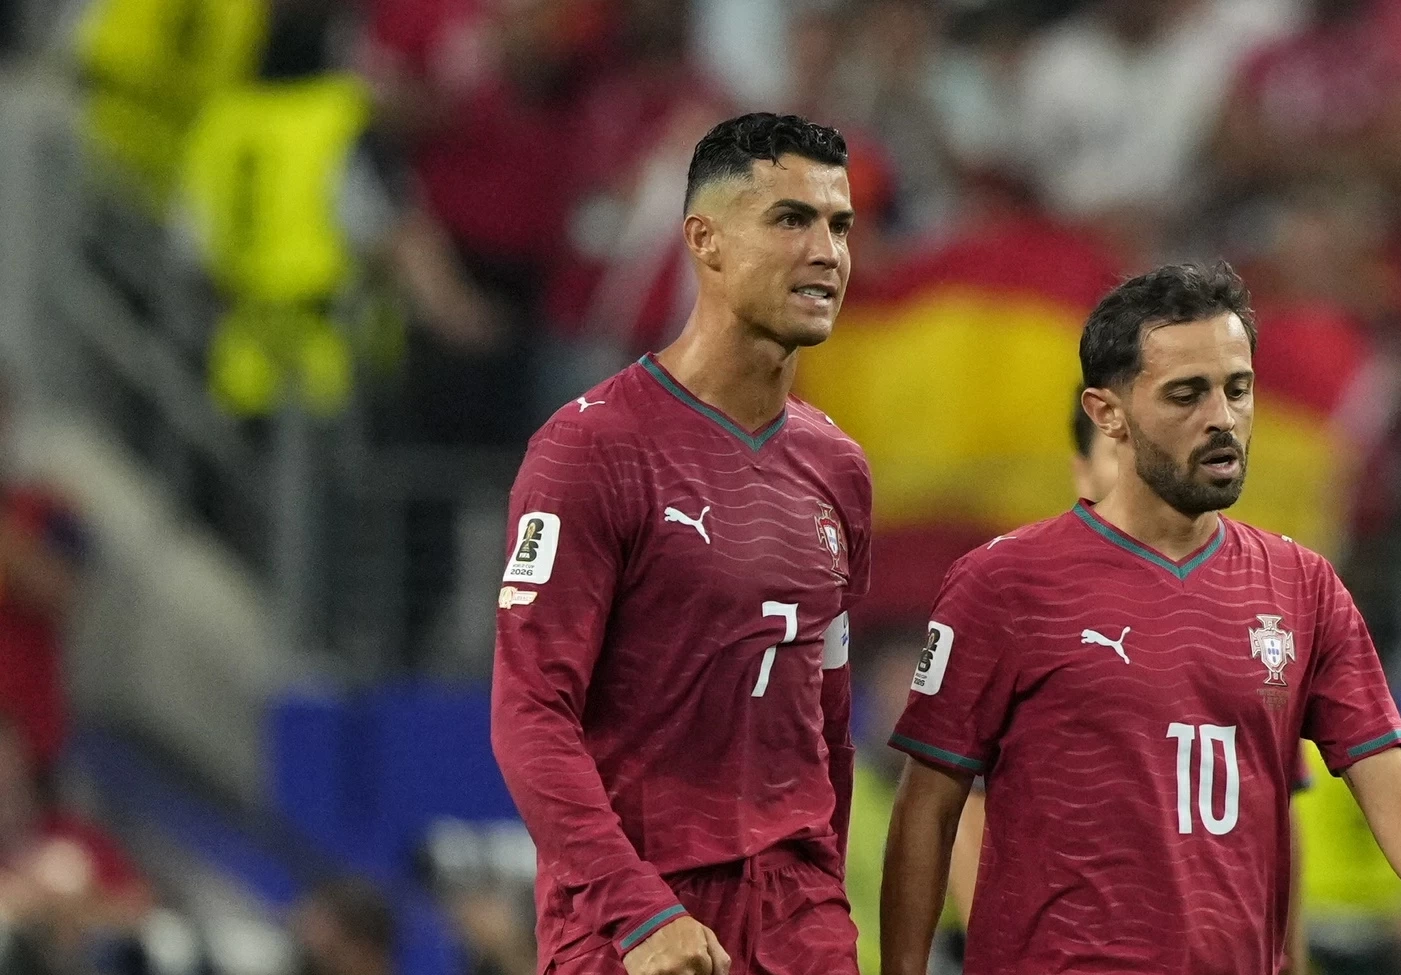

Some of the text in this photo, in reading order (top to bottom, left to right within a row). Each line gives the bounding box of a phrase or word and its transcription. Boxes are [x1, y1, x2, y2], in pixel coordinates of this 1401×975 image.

[510, 568, 534, 577] 2026
[751, 600, 799, 697] 7
[1165, 722, 1240, 835] 10
